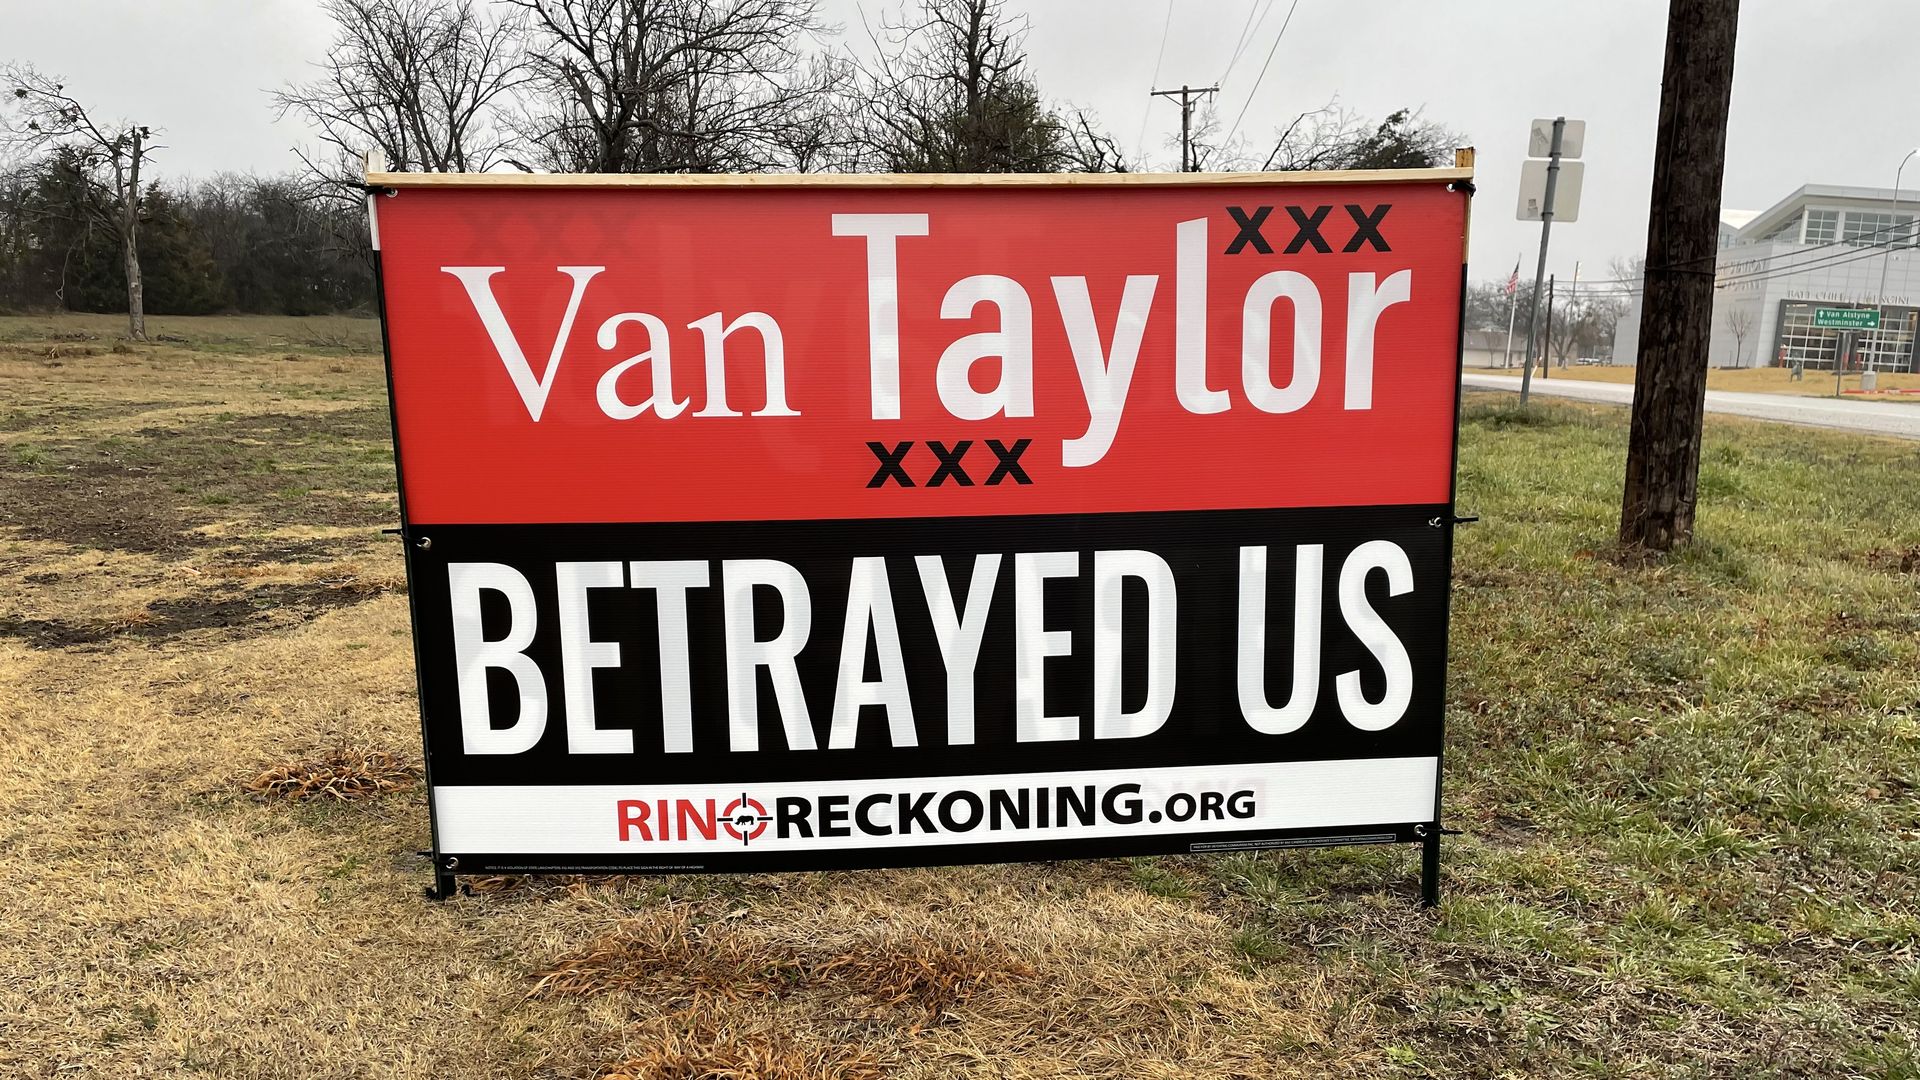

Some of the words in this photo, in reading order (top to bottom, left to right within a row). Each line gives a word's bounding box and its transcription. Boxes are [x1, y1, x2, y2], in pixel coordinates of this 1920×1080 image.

[441, 265, 802, 423] Van
[831, 213, 1412, 468] Taylor
[1817, 318, 1863, 327] Westminster
[1842, 311, 1871, 320] Alstyne
[448, 549, 1178, 755] BETRAYED
[1237, 540, 1414, 735] US
